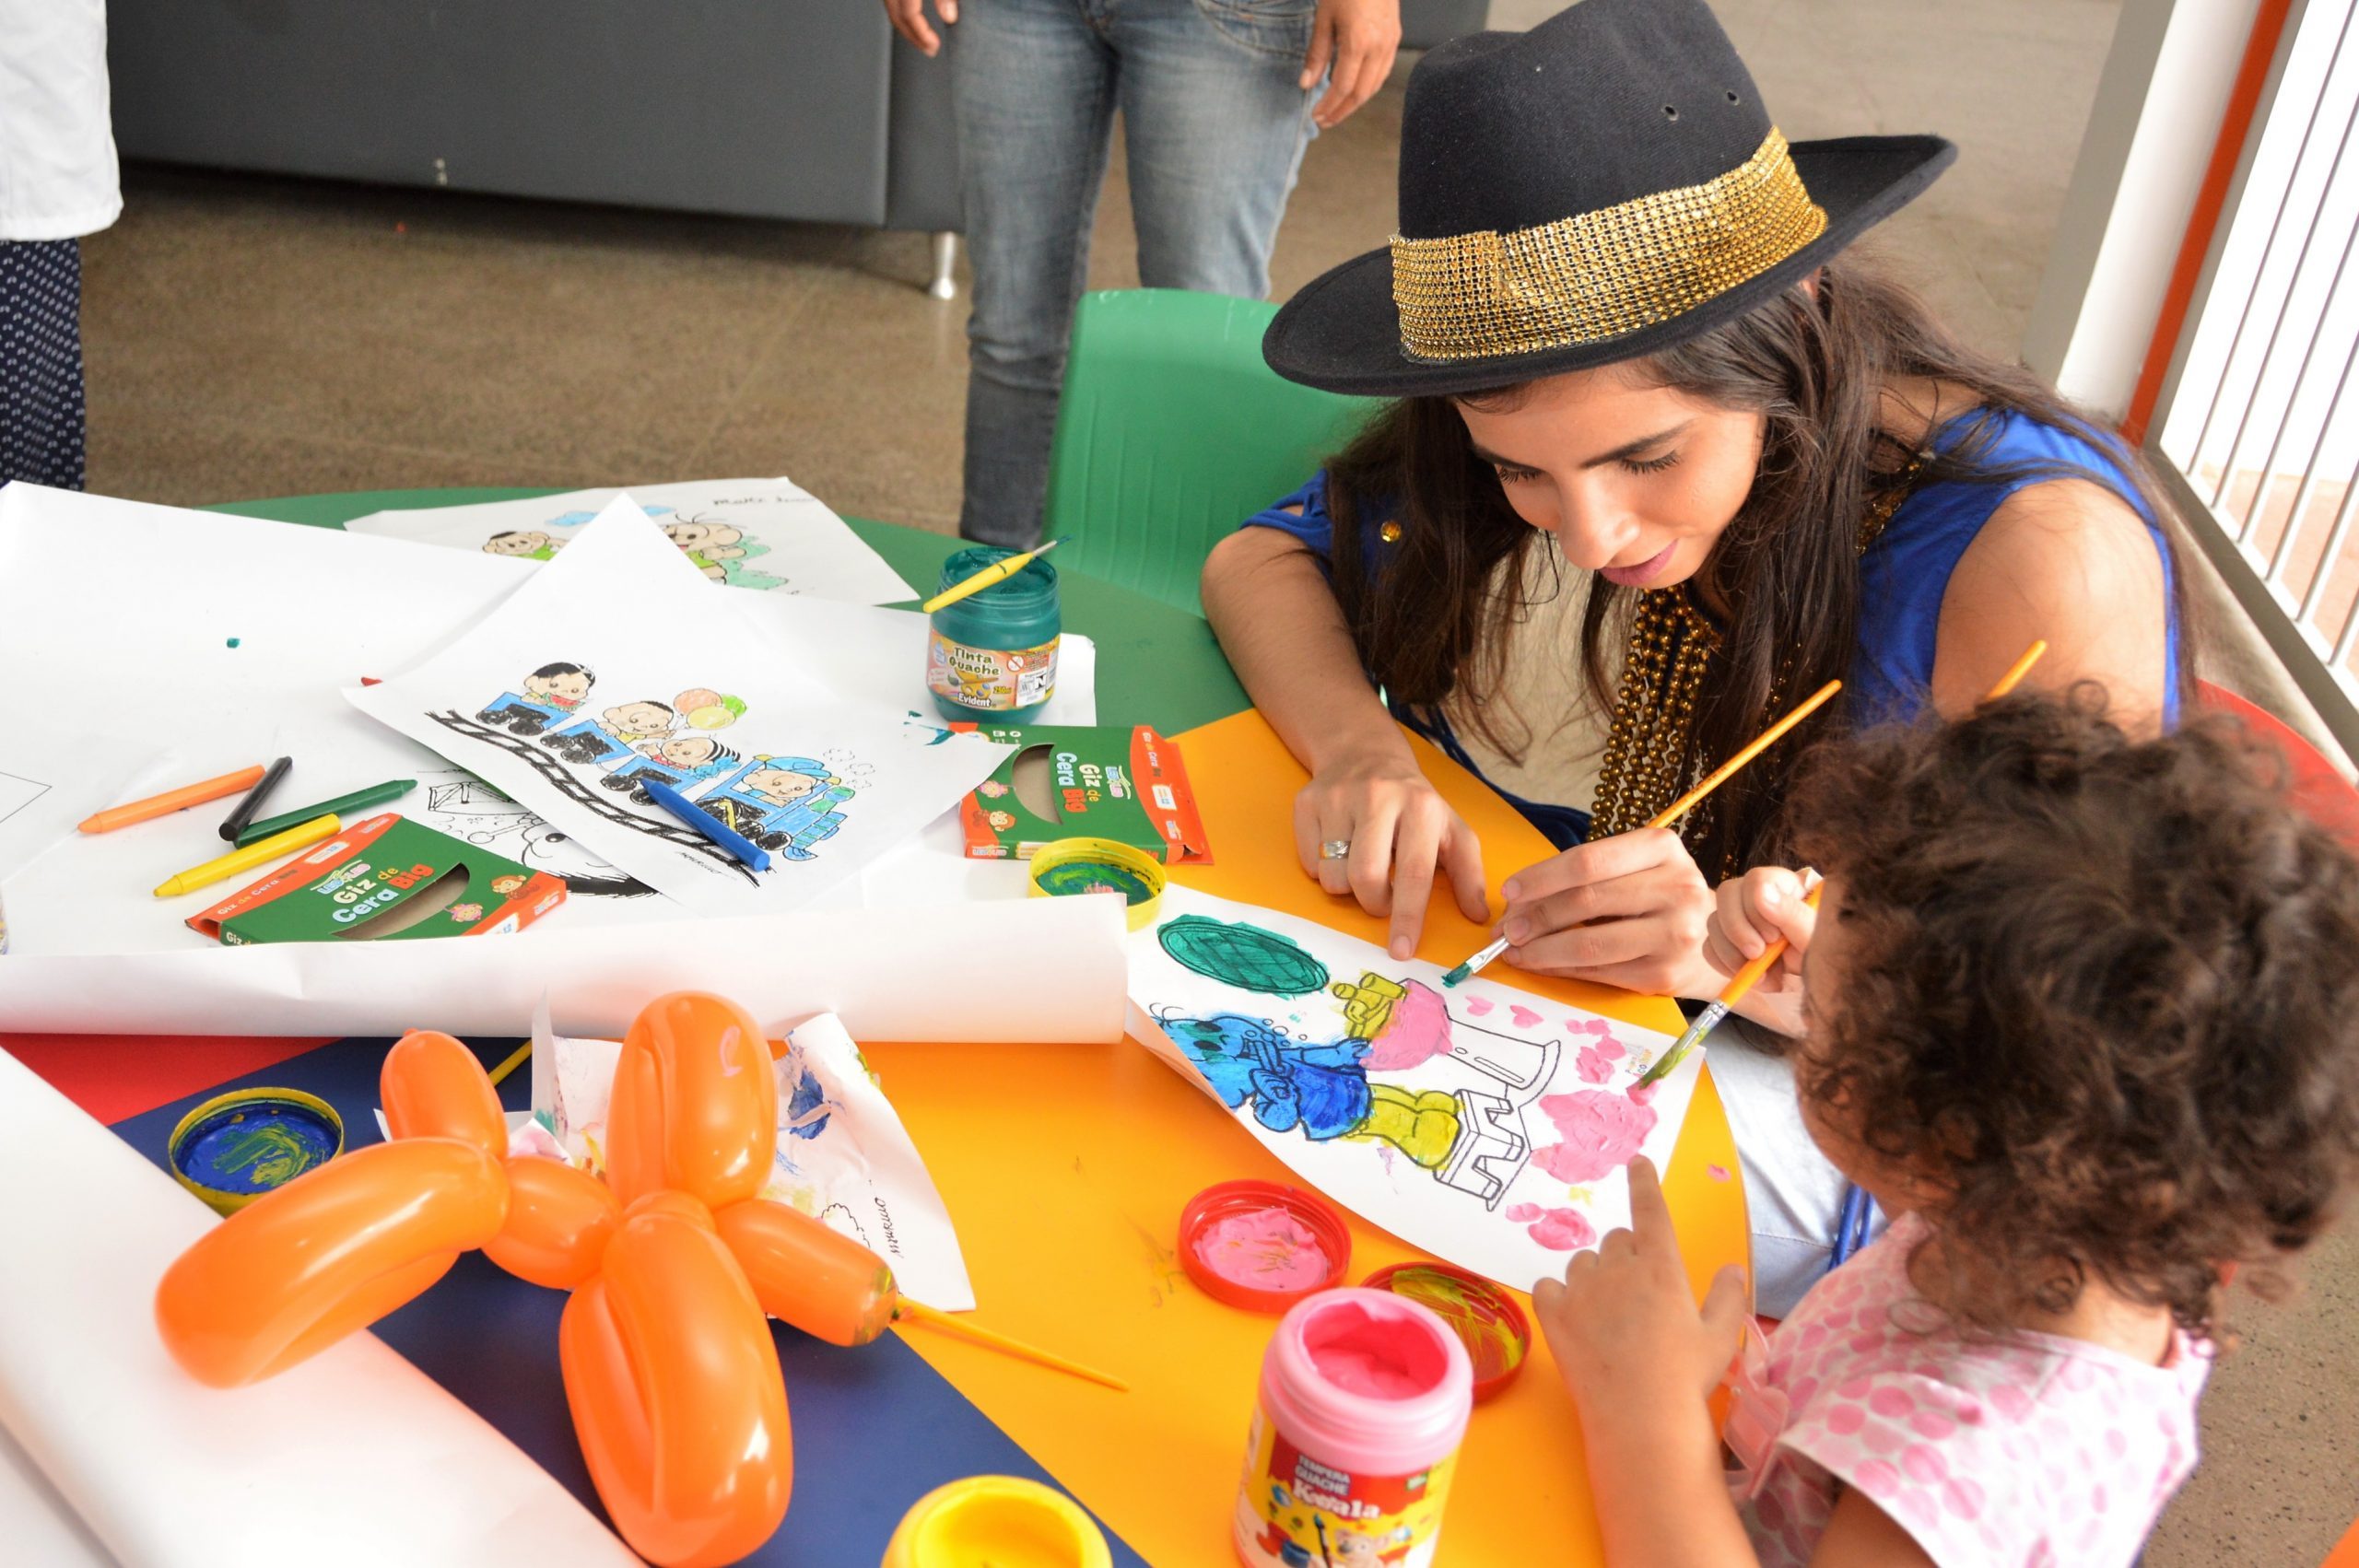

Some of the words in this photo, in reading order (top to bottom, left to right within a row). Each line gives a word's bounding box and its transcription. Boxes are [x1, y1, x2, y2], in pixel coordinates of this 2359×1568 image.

[954, 647, 993, 664] Tinta
[958, 692, 992, 708] Evident
[1056, 752, 1078, 786] Cera
[1079, 764, 1103, 788] Giz
[1062, 789, 1088, 813] Big
[1086, 790, 1102, 802] de
[332, 888, 399, 922] Cera
[387, 863, 435, 890] Big
[333, 879, 378, 904] Giz
[378, 868, 399, 880] de
[226, 931, 242, 945] Giz
